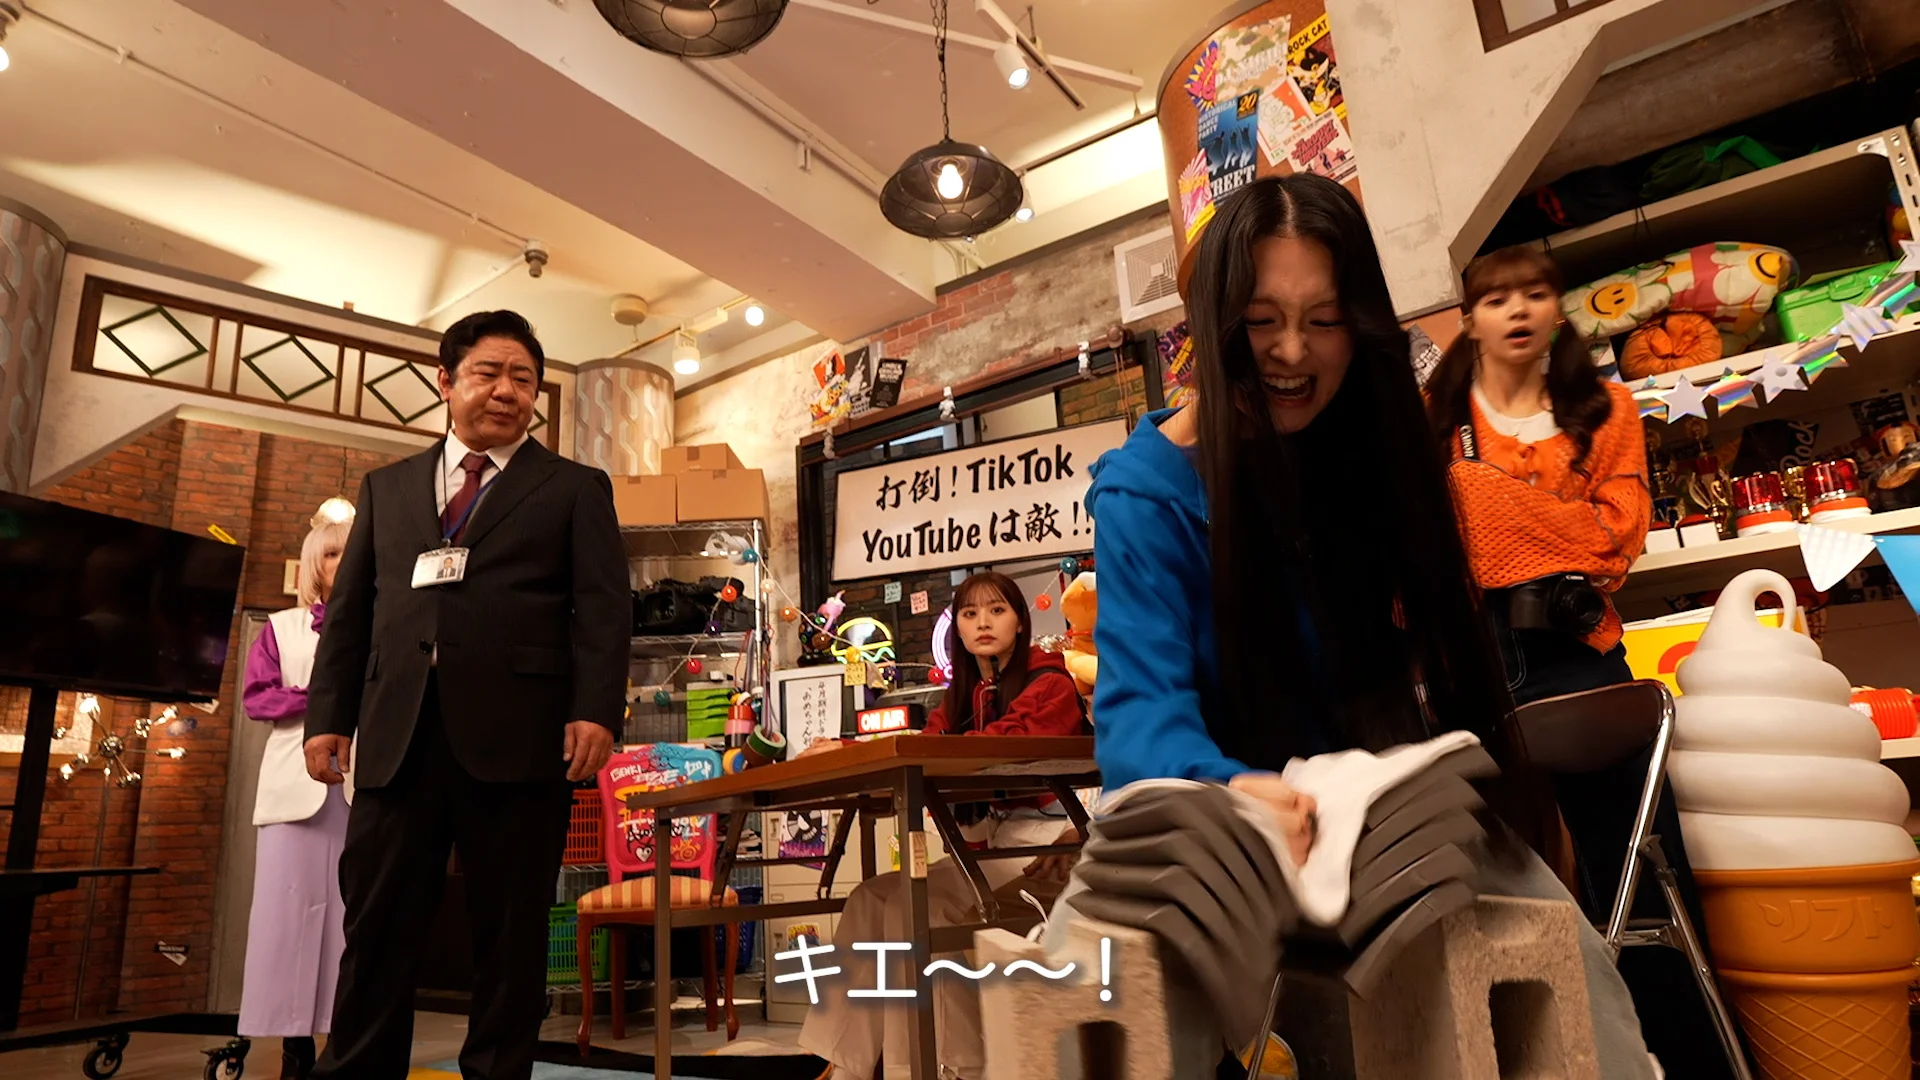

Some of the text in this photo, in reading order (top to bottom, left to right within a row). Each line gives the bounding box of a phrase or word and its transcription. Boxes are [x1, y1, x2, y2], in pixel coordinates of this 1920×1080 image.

[1288, 19, 1328, 56] ROCK CAT
[1239, 92, 1257, 111] 20
[861, 708, 906, 732] ON AIR
[1760, 895, 1895, 943] ソフト
